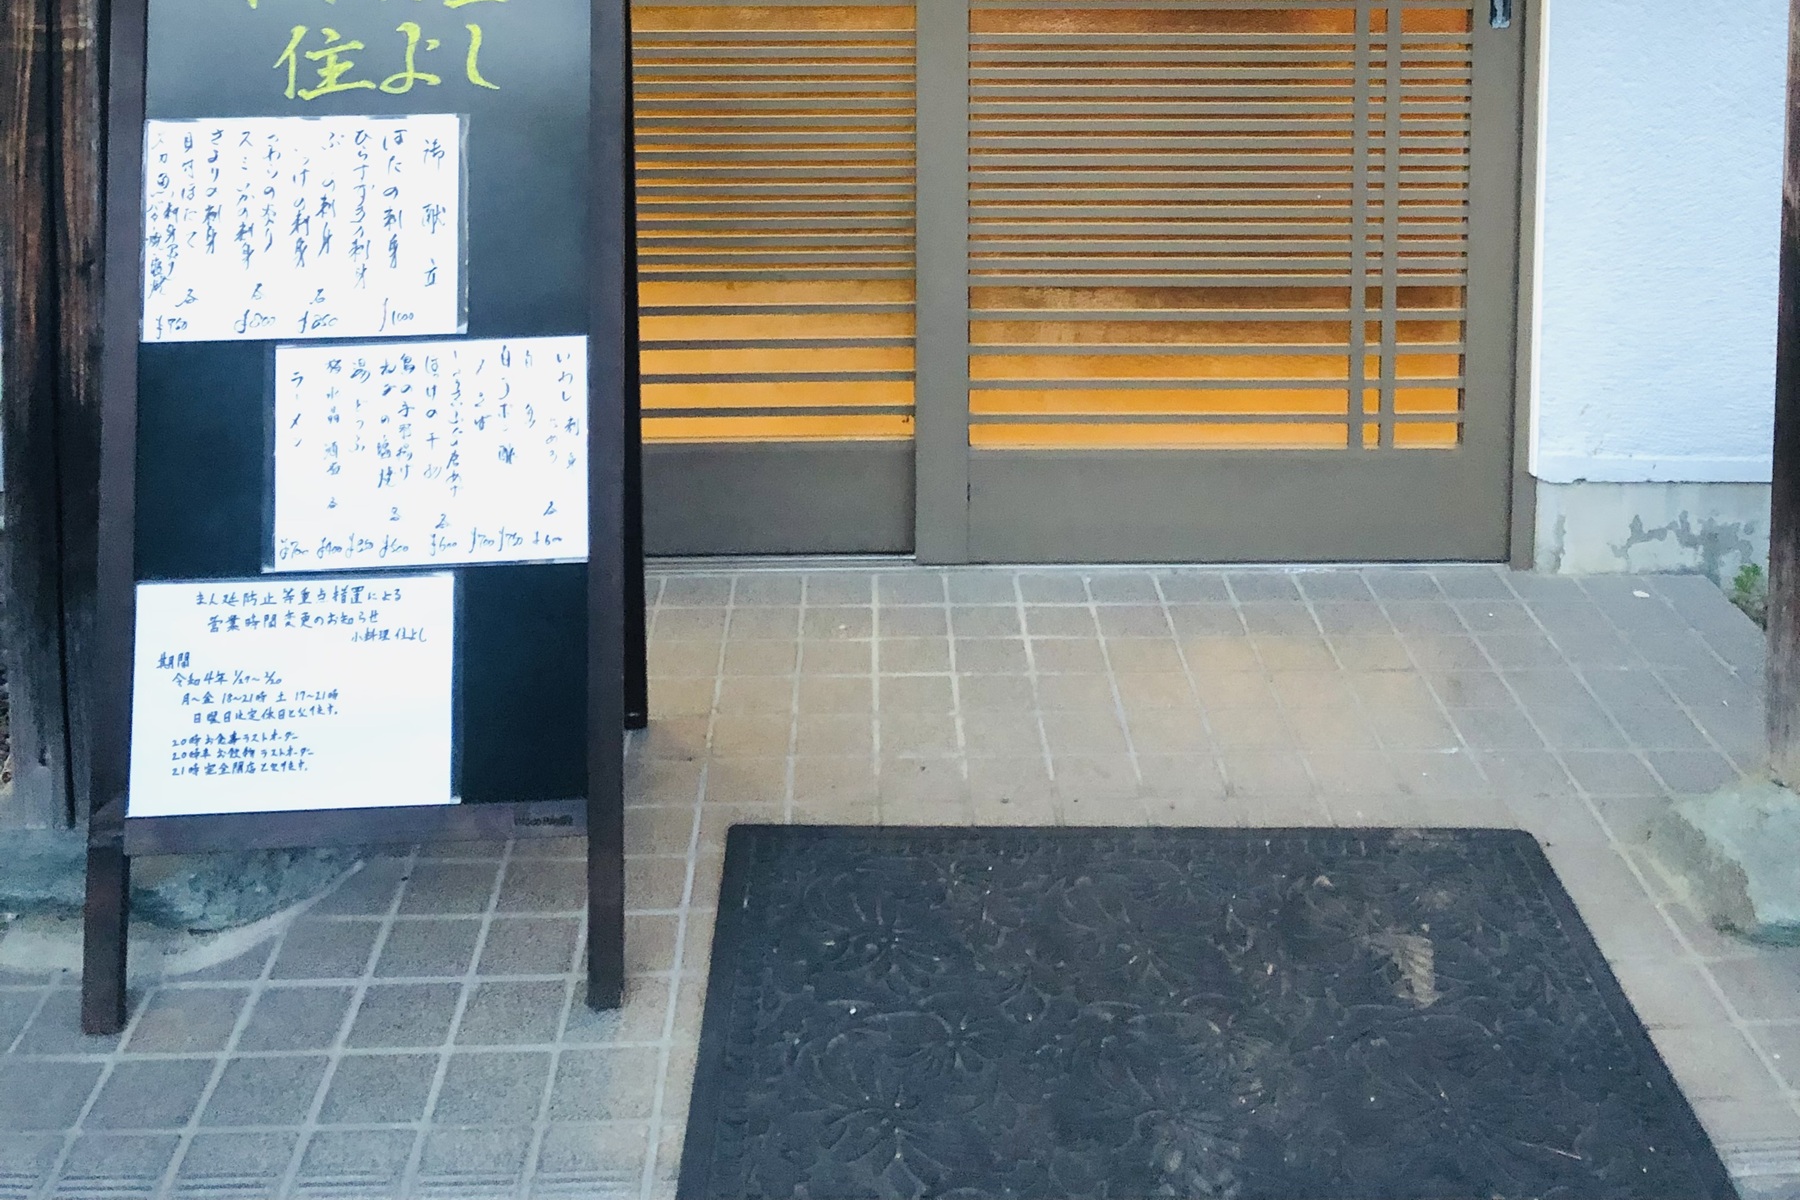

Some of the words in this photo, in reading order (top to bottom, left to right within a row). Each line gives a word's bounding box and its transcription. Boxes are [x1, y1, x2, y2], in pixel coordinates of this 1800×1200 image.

[273, 22, 500, 101] 住よし
[207, 609, 379, 633] 営業時間変更のお知らせ
[156, 651, 190, 670] 期間
